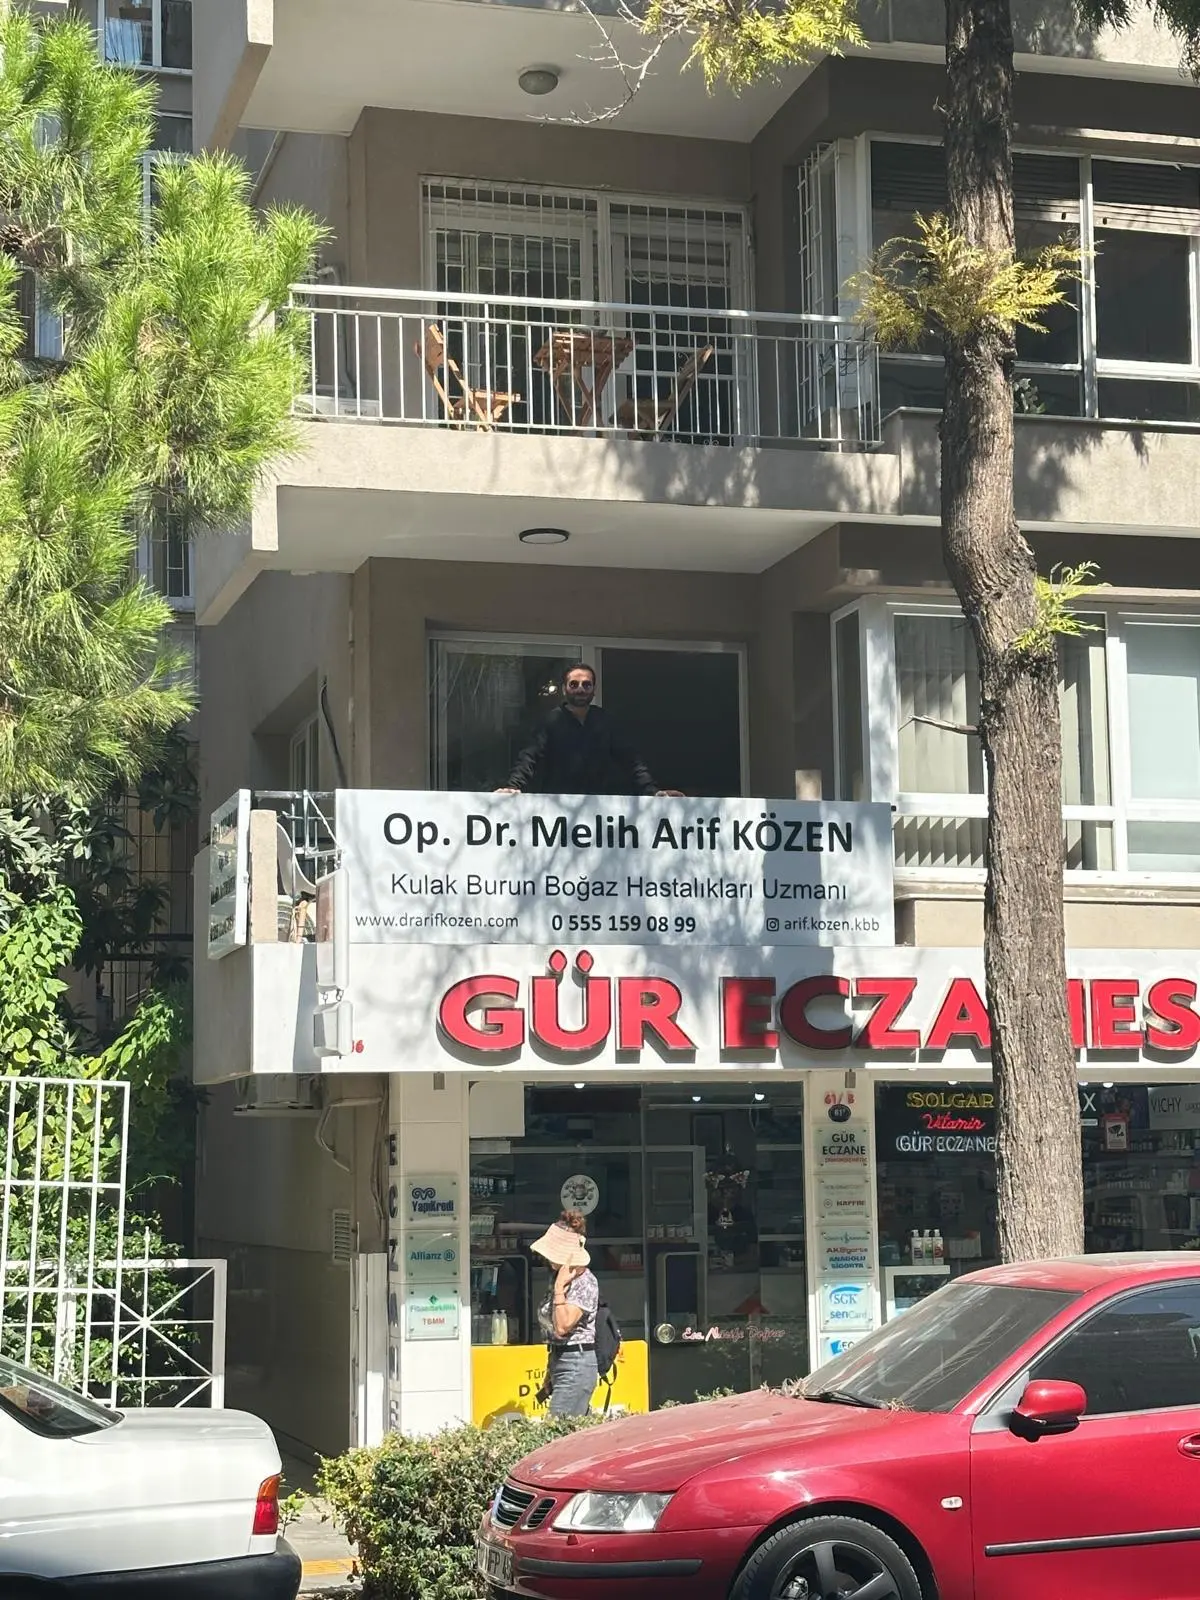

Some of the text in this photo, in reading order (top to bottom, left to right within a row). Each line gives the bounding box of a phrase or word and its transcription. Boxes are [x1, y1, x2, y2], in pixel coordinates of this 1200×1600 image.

[383, 812, 853, 853] Op. Dr. Melih Arif KÖZEN
[391, 872, 847, 902] Kulak Burun Boğaz Hastalıkları Uzmanı
[355, 912, 519, 928] www.drarifkozen.com
[551, 914, 696, 933] 0 555 159 08 99
[784, 917, 880, 932] arif.kozen.kbb
[437, 949, 1200, 1051] GÜR ECZAES
[908, 1091, 995, 1109] SOLGAR
[1150, 1096, 1182, 1113] VICHY
[922, 1112, 986, 1130] Vitamin
[831, 1131, 856, 1144] GÜR
[899, 1130, 933, 1152] GÜR
[822, 1145, 867, 1156] ECZANE
[410, 1250, 443, 1261] Allianz
[833, 1293, 858, 1305] SGK
[525, 1368, 546, 1380] Tür
